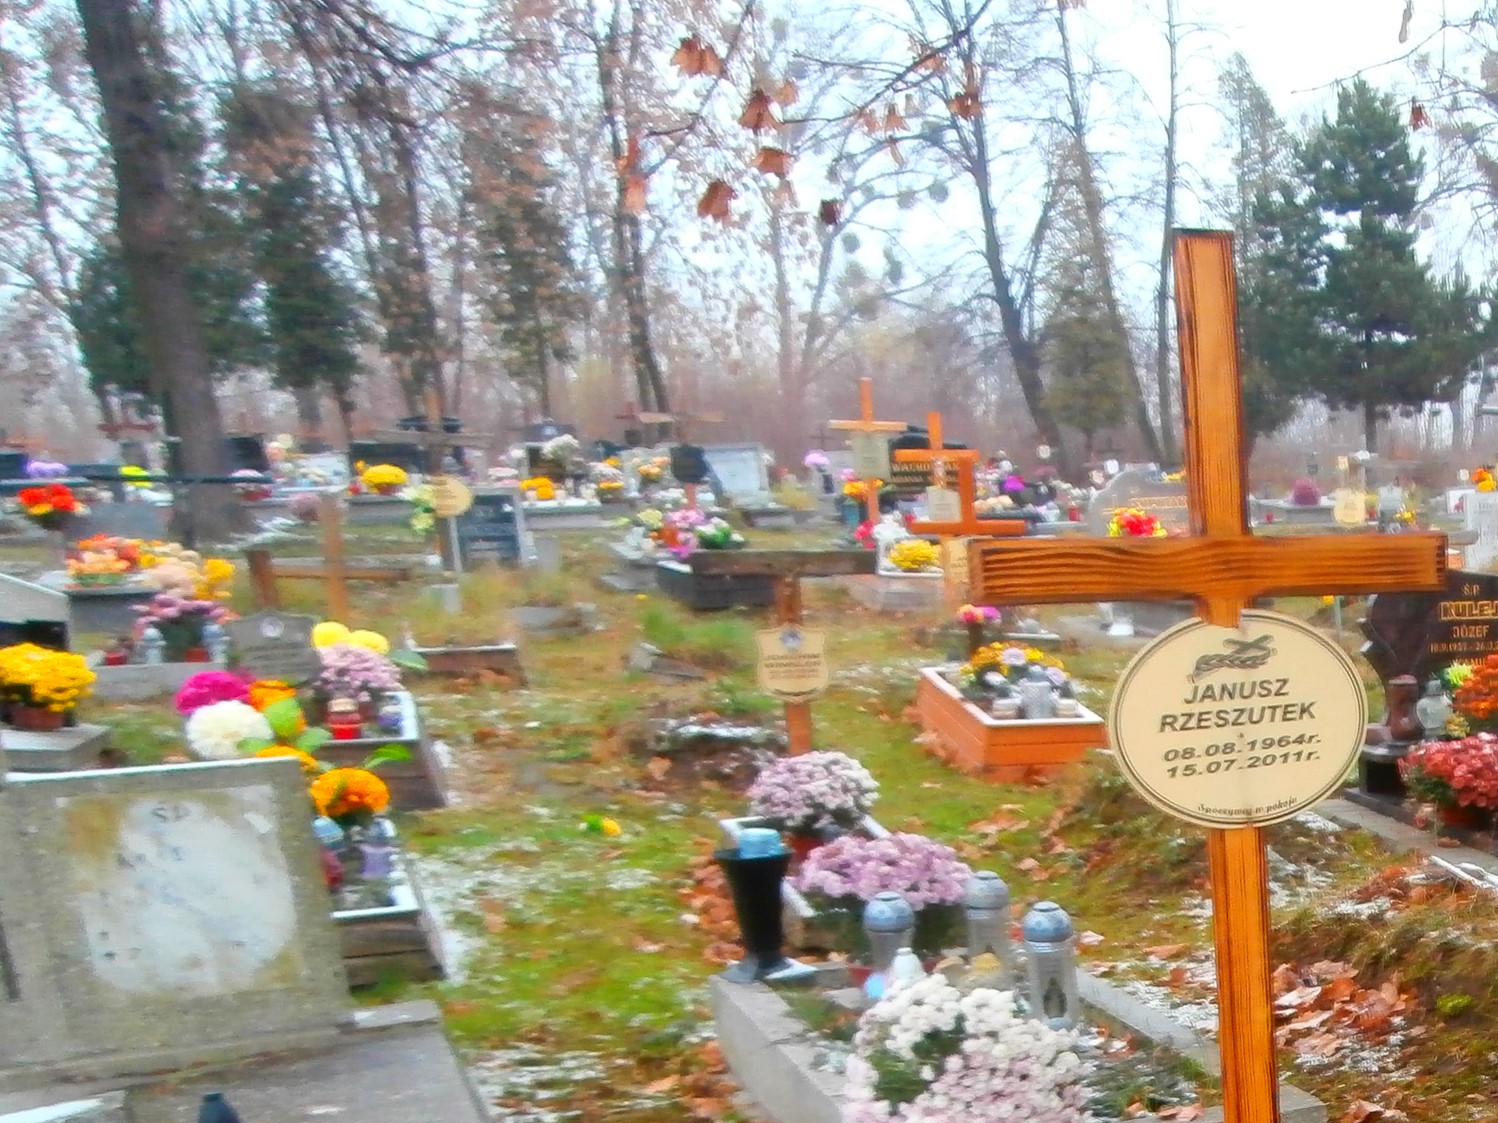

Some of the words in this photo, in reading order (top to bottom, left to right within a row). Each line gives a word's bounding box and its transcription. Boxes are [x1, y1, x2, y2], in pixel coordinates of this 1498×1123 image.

[1184, 678, 1290, 704] JANUSZ
[1159, 701, 1317, 733] RZESZUTEK
[1164, 732, 1322, 762] 08.08.1964r.
[1166, 750, 1321, 779] 15.07.2011r.
